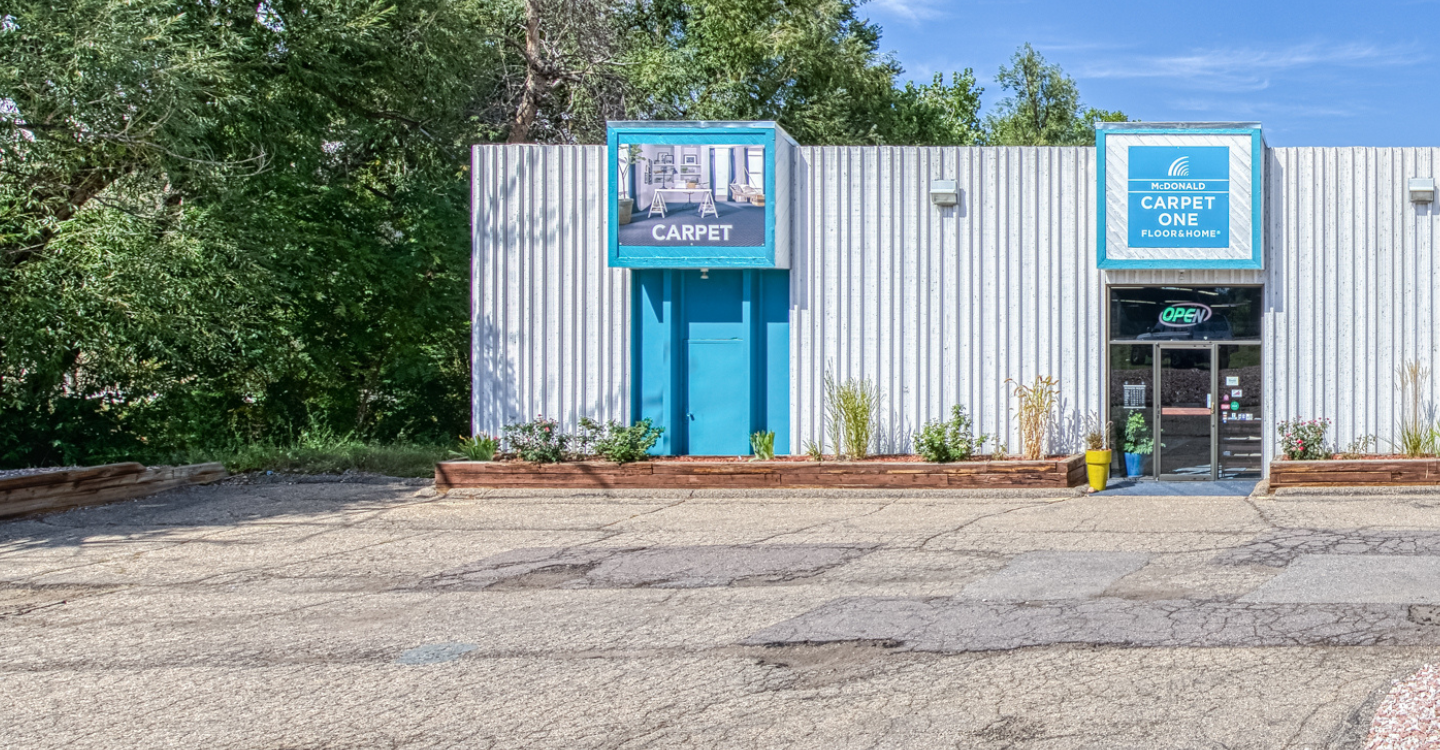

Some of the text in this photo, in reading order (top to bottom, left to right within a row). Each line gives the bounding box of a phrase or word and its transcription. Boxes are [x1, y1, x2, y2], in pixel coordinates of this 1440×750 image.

[1151, 182, 1206, 190] McDONALD
[1141, 196, 1216, 210] CARPET
[1158, 213, 1199, 226] ONE
[652, 224, 733, 241] CARPET
[1162, 306, 1206, 324] OPEN
